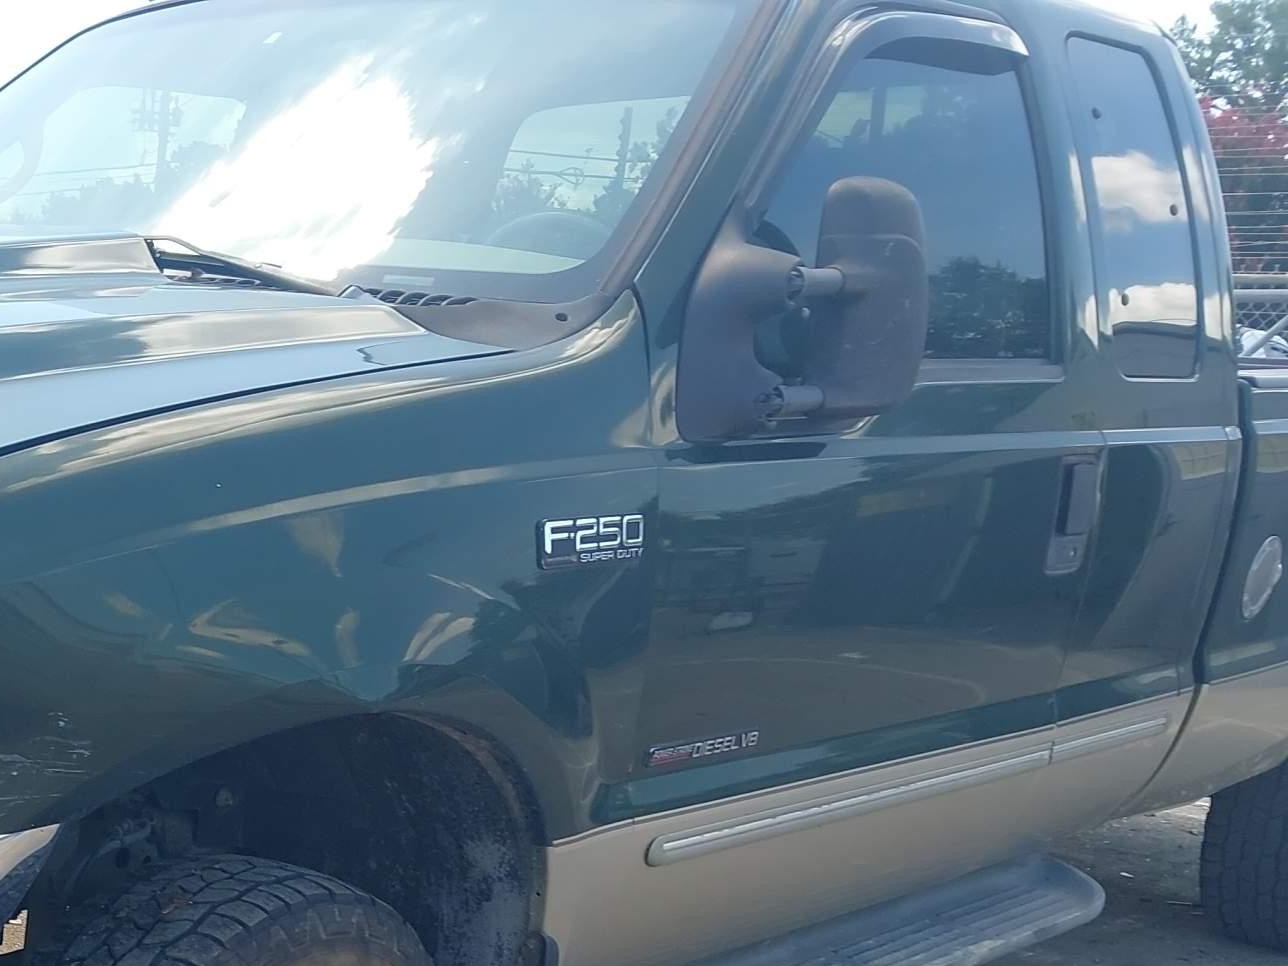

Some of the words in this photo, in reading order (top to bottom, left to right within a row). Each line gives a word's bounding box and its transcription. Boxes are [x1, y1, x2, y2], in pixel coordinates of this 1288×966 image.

[579, 550, 615, 563] SUPER
[616, 547, 645, 560] DUTY
[691, 734, 740, 758] DIESEL
[741, 730, 760, 747] V8
